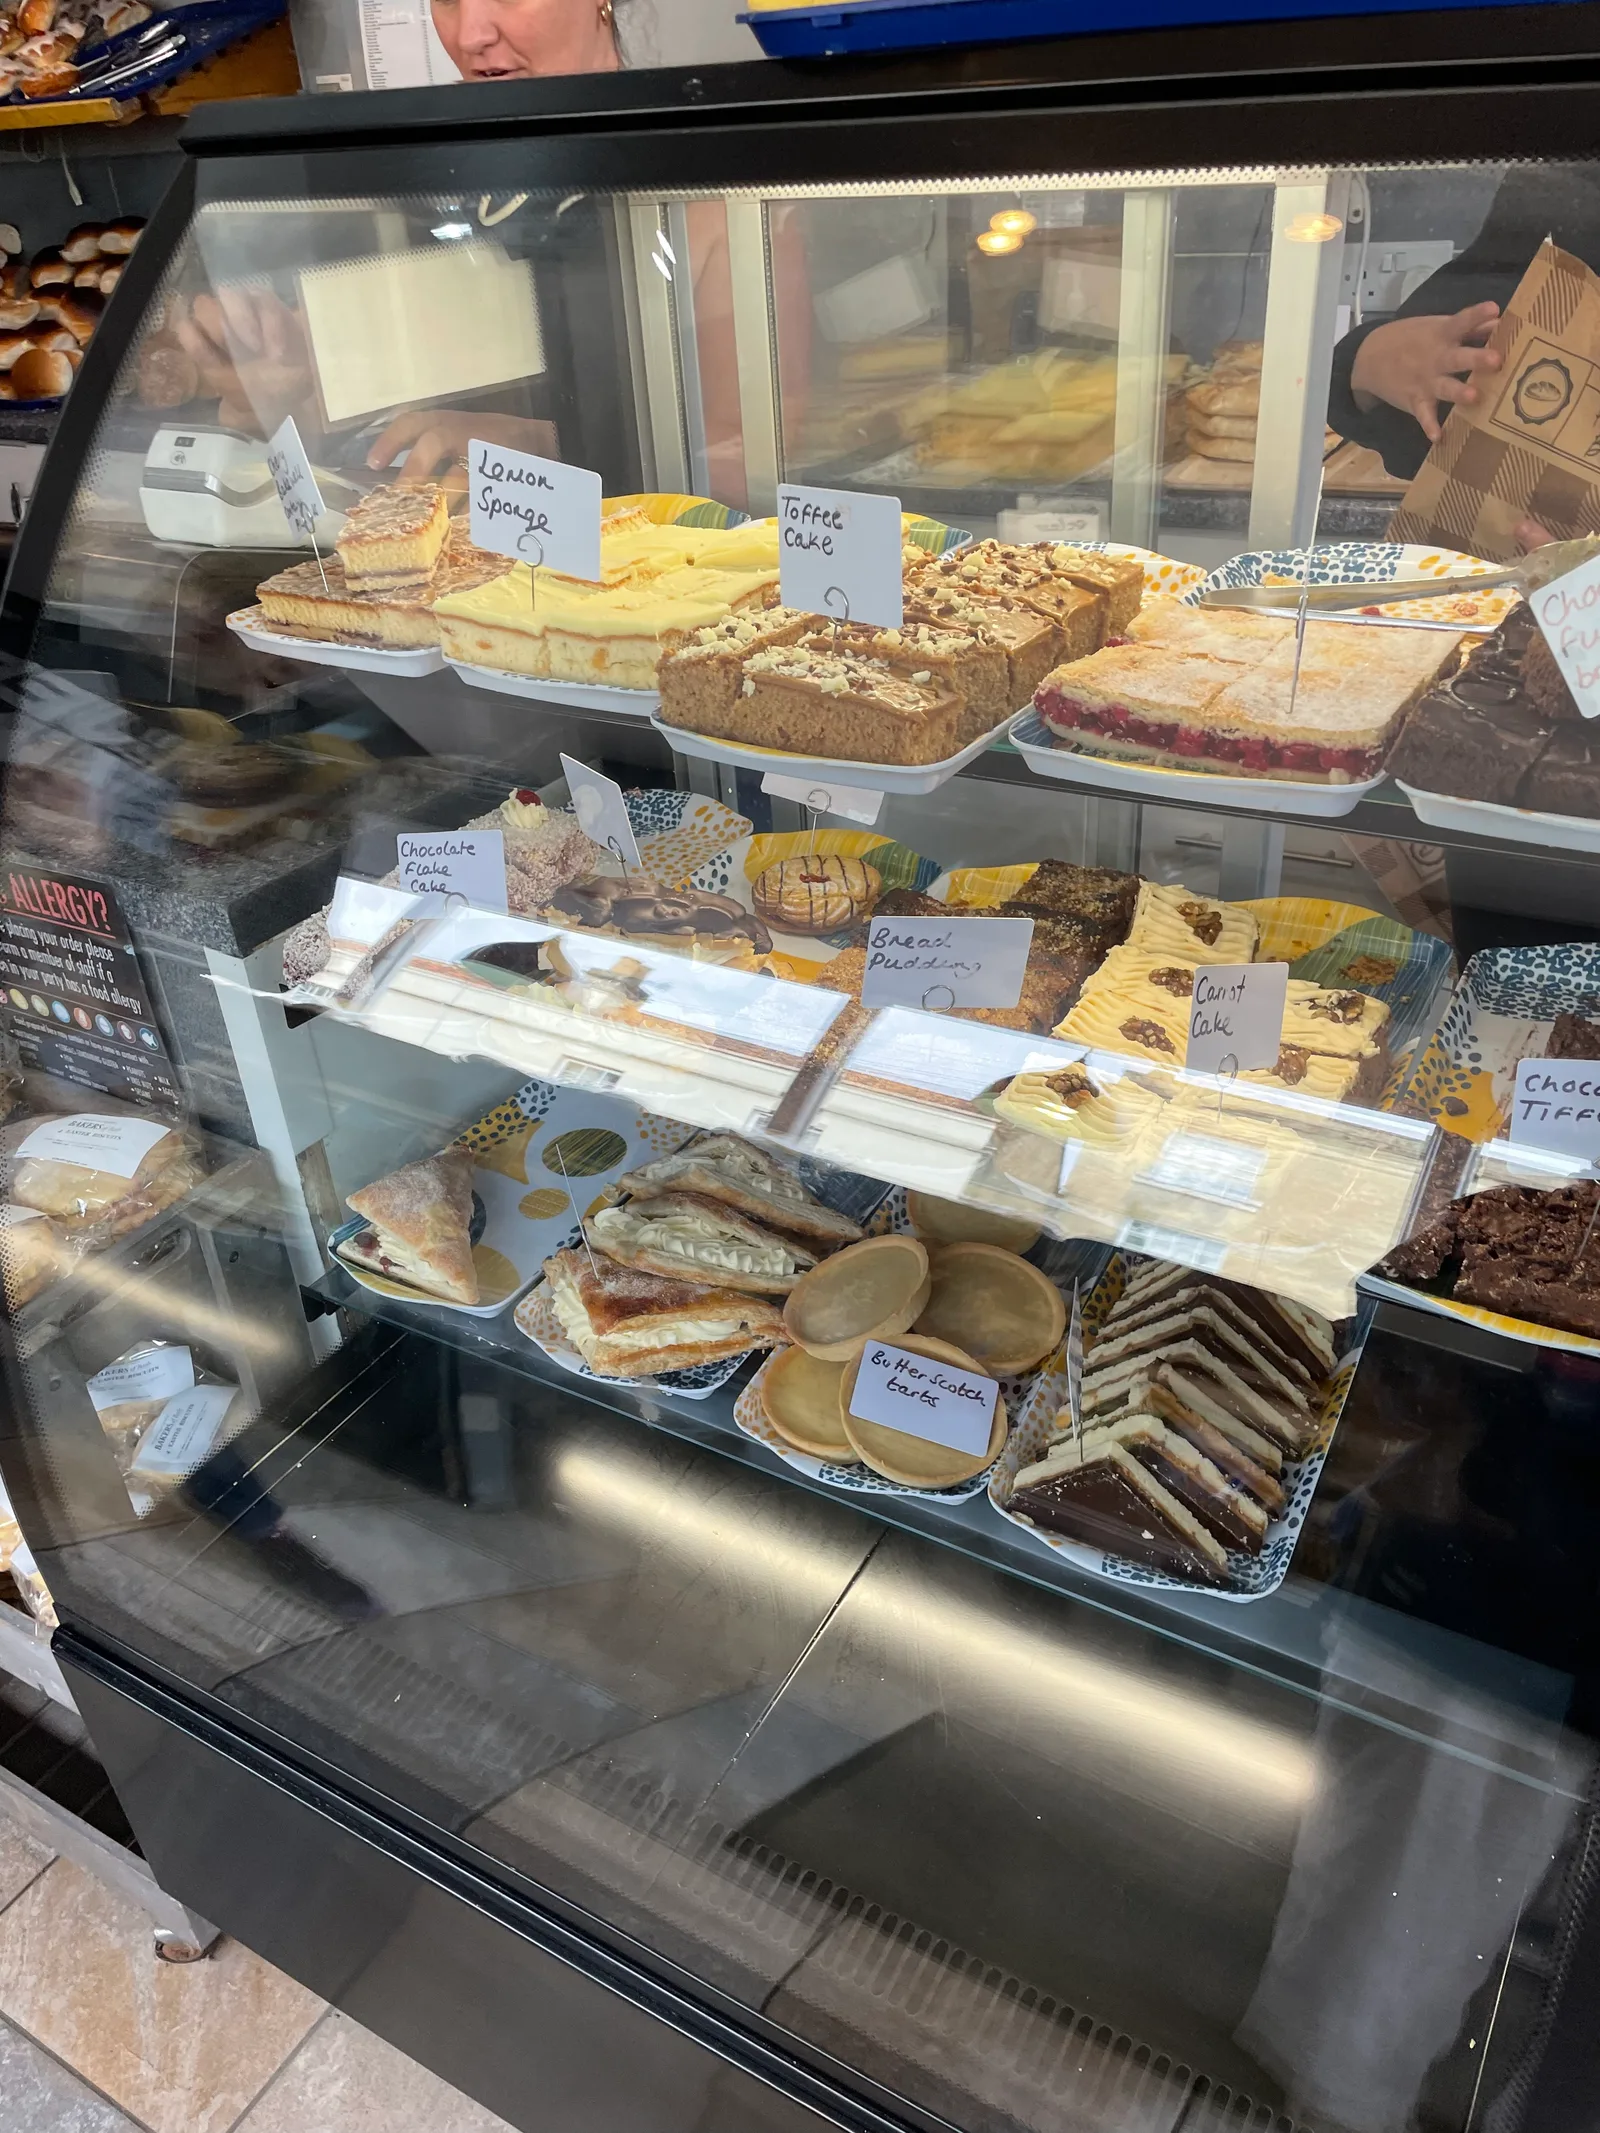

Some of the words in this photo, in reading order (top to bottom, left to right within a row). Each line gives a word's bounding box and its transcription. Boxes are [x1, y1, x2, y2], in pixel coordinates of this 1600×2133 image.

[479, 449, 554, 490] Lemon
[477, 486, 553, 535] Sponge
[781, 496, 843, 530] Toffee
[784, 527, 834, 556] Cake
[1542, 584, 1600, 627] Cho
[400, 840, 476, 858] Chocolate
[405, 861, 452, 877] Flake
[9, 872, 112, 931] ALLERGY?
[410, 878, 452, 894] Cake
[6, 916, 39, 946] placing
[37, 930, 59, 947] your
[60, 932, 84, 954] order
[85, 937, 115, 962] please
[871, 927, 953, 949] Bread
[28, 947, 64, 969] member
[65, 953, 76, 972] of
[76, 958, 98, 979] staff
[96, 961, 106, 981] if
[106, 969, 114, 984] a
[8, 959, 20, 975] in
[19, 965, 40, 981] your
[41, 972, 65, 992] party
[62, 972, 82, 994] has
[81, 983, 89, 996] a
[87, 979, 111, 1003] food
[110, 987, 143, 1016] allergy
[1191, 1010, 1234, 1039] Cake
[96, 1367, 129, 1378] AKERS
[886, 1376, 940, 1408] tarts
[154, 1423, 174, 1451] BAKERS
